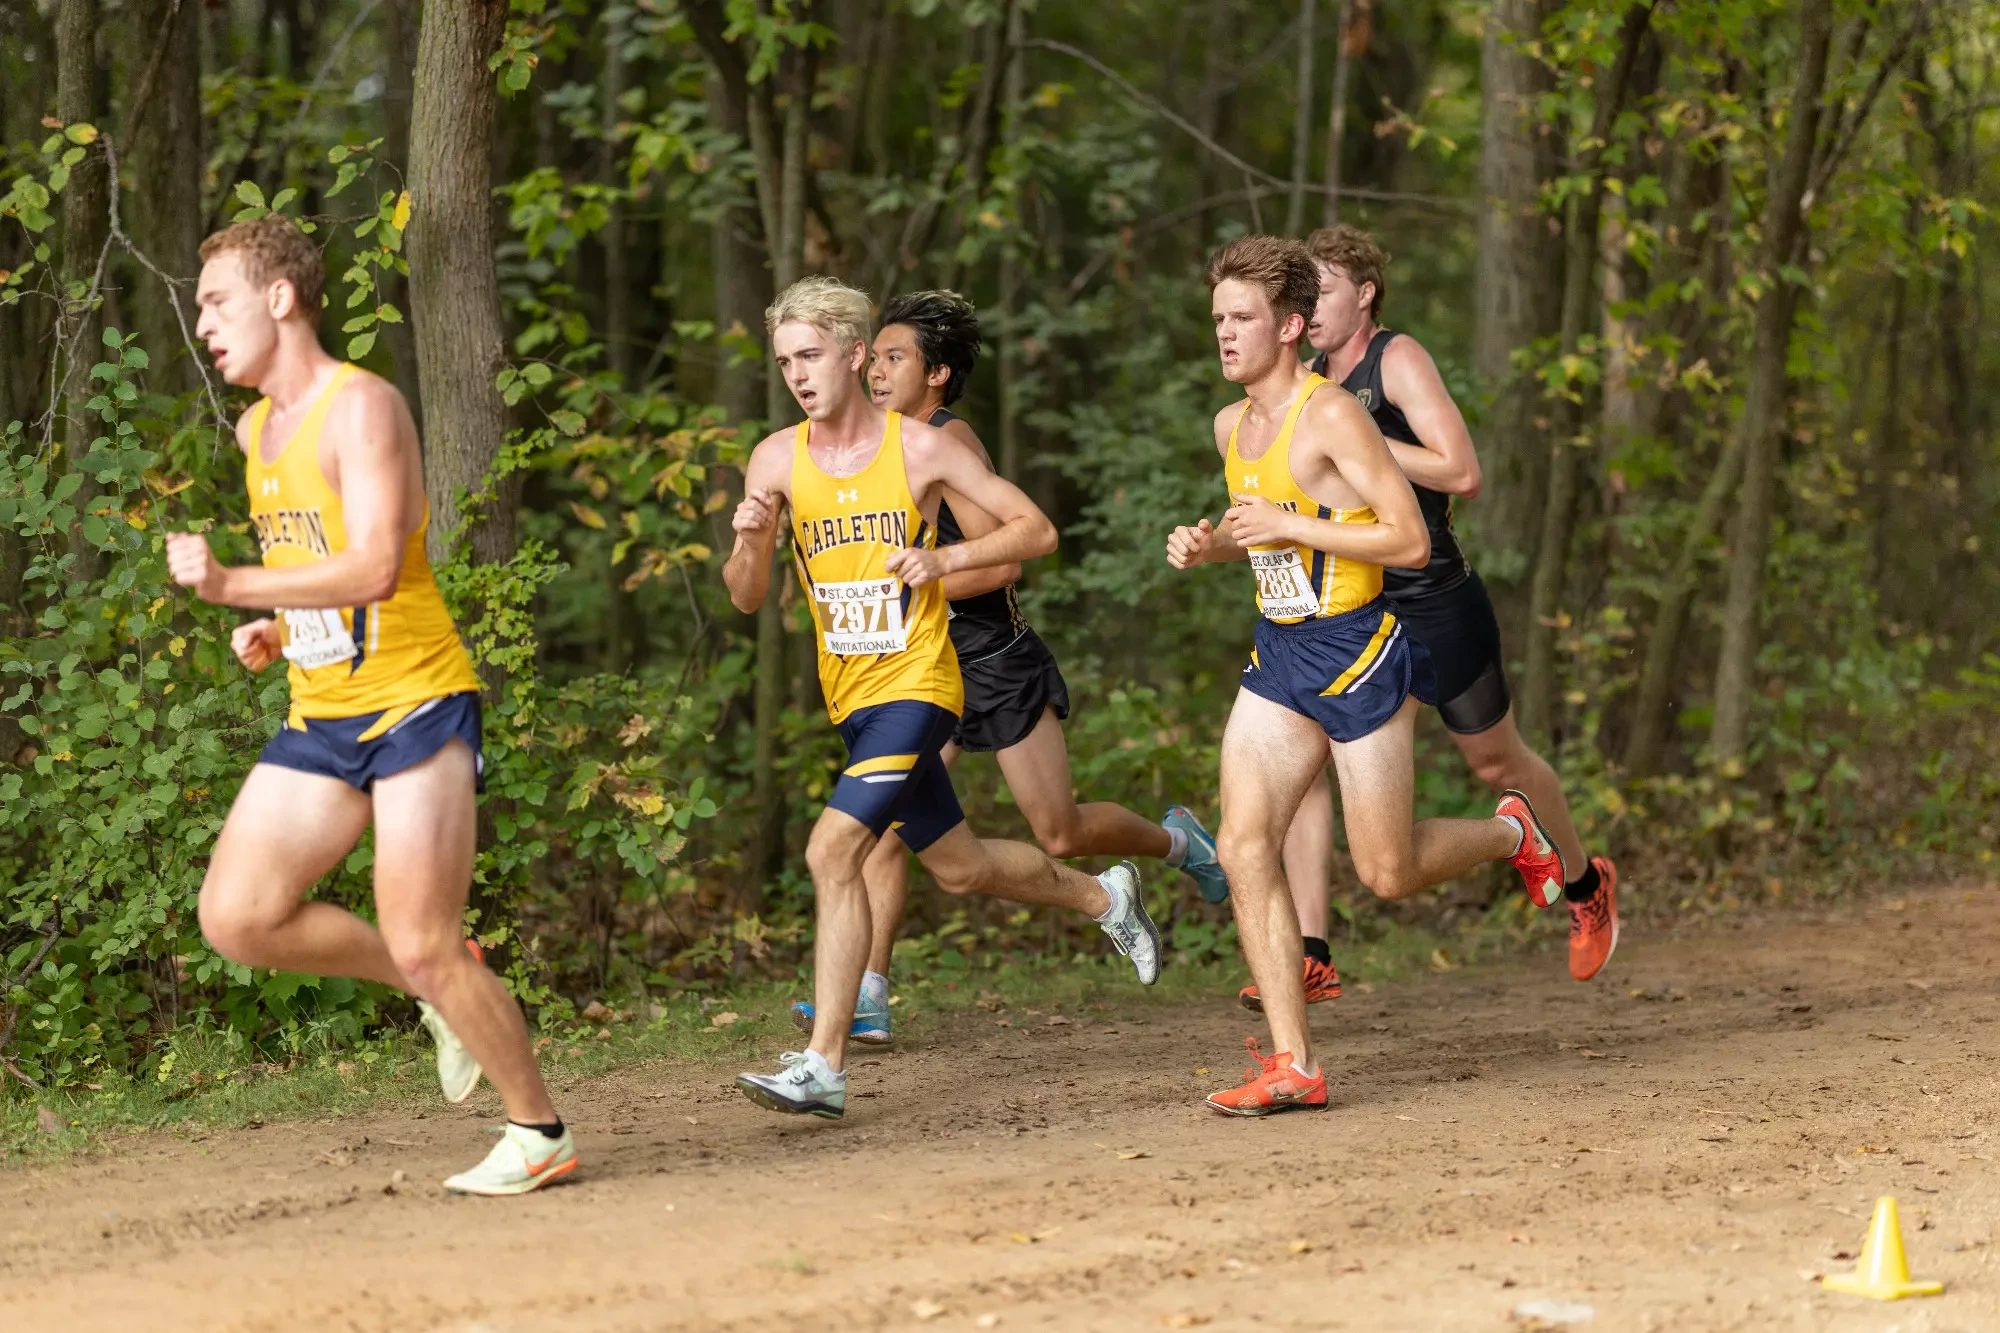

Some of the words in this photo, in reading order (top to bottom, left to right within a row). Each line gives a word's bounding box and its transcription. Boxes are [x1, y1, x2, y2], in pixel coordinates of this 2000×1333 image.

[802, 511, 906, 559] CARLETON
[1262, 554, 1284, 567] OLAF
[828, 588, 844, 599] ST.
[845, 585, 878, 599] OLAF
[1256, 568, 1295, 598] 288
